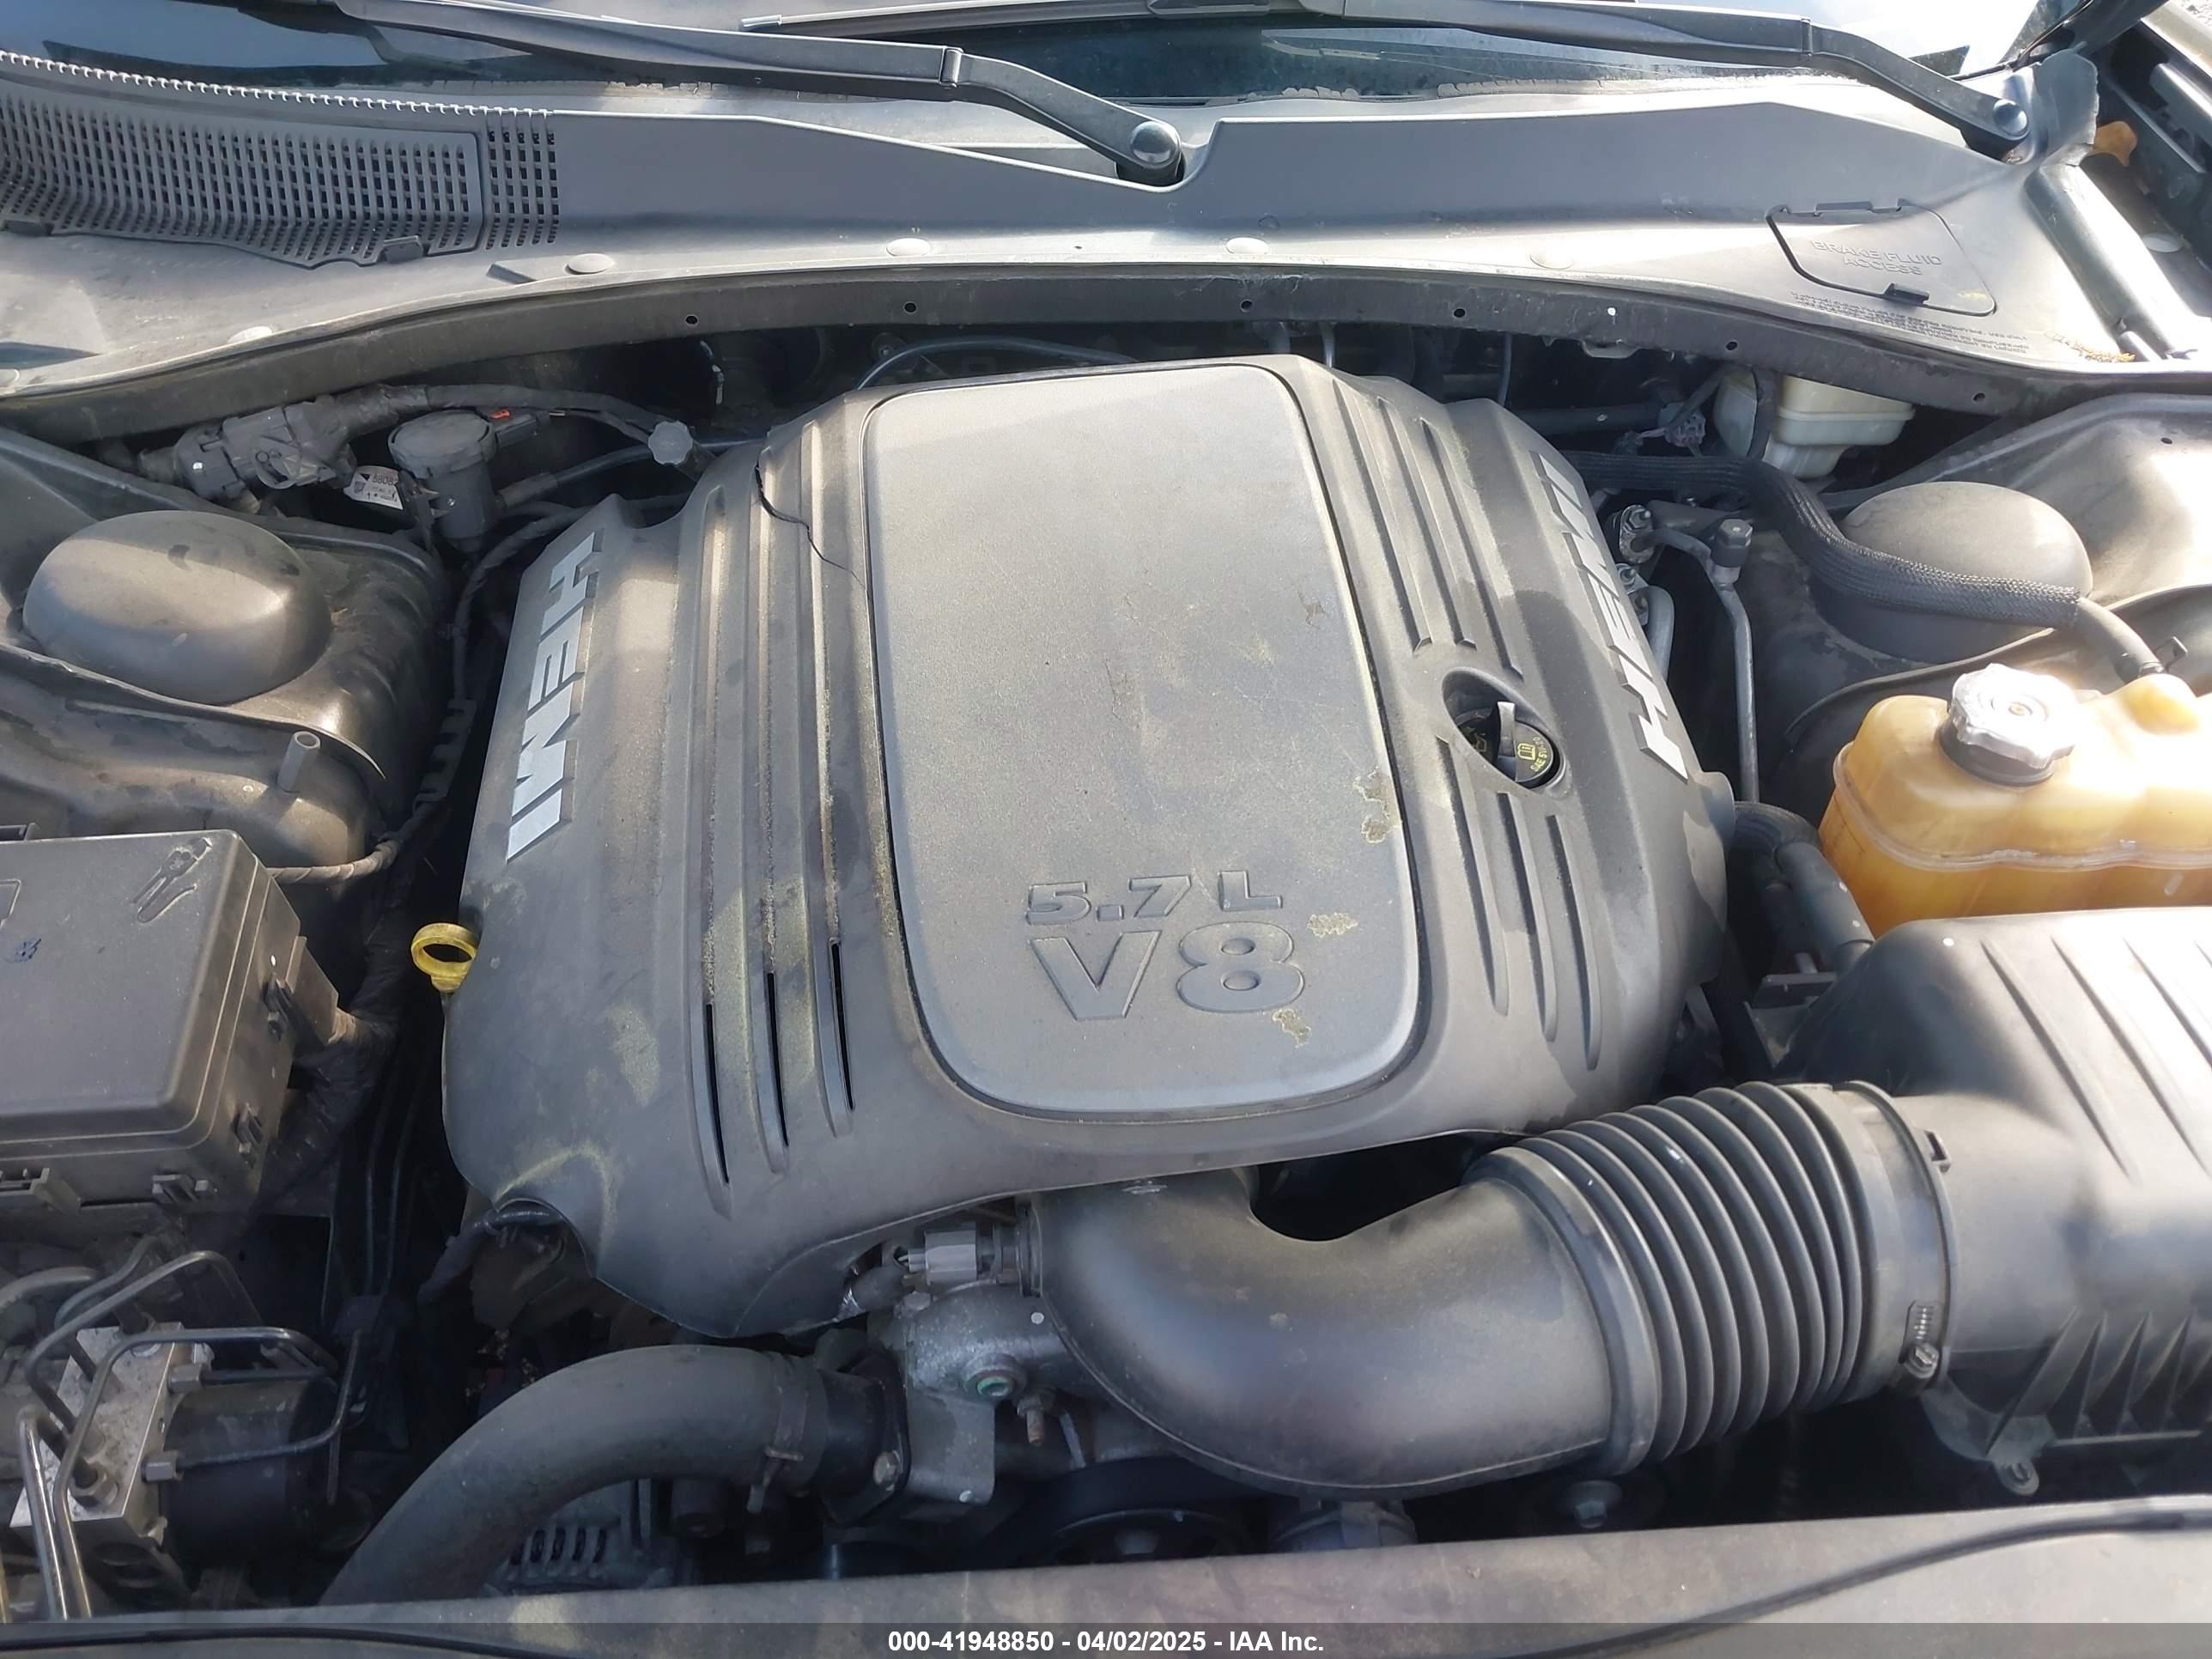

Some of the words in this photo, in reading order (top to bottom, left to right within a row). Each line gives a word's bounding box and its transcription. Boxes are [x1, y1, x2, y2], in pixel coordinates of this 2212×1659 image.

[1810, 240, 1884, 258] BRAKE
[1884, 251, 1943, 265] FLUID
[1844, 256, 1923, 276] ACCESS
[1539, 452, 1689, 783] HEMI
[507, 531, 595, 861] HEMI
[1530, 757, 1546, 771] SAE
[1030, 921, 1305, 1021] V8
